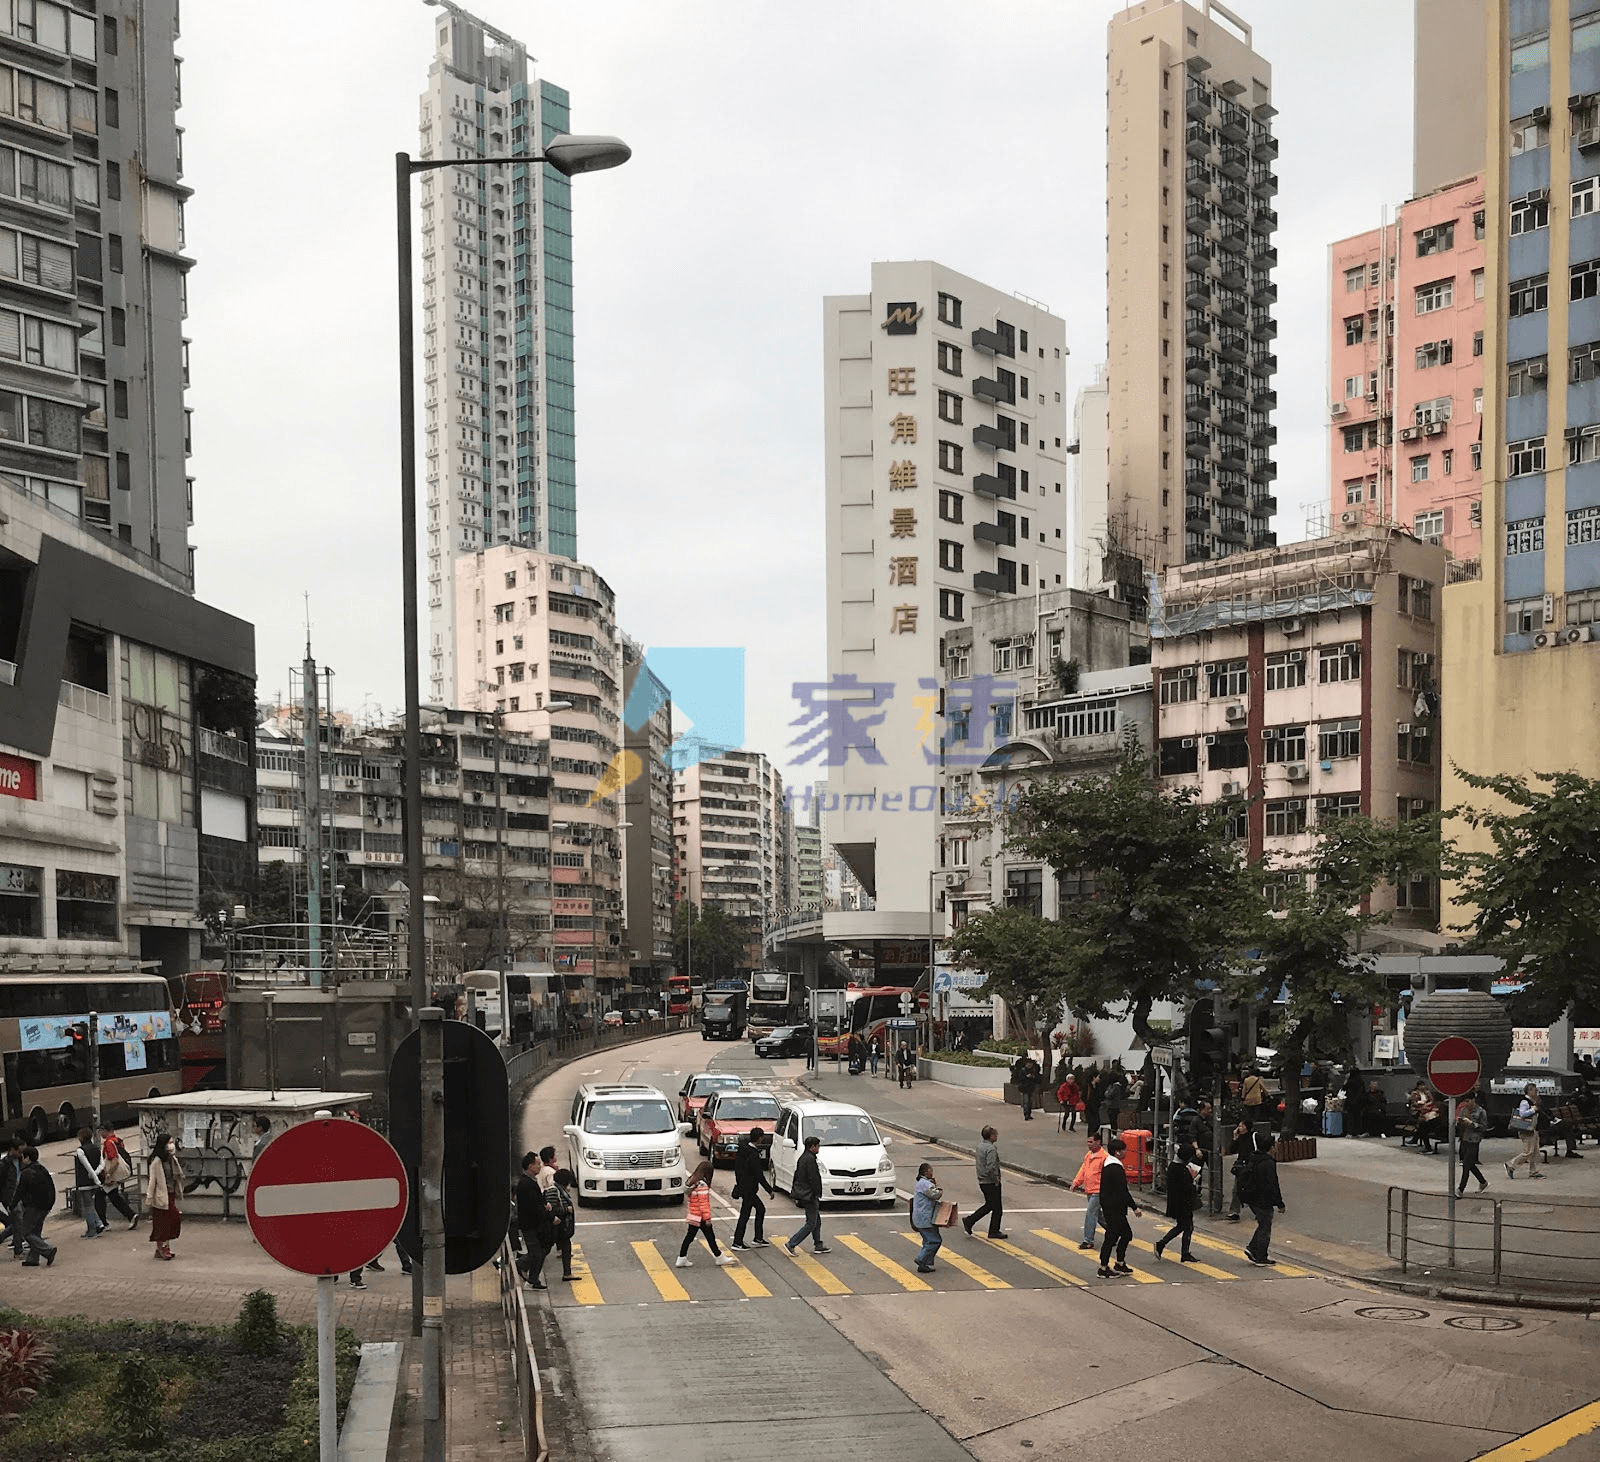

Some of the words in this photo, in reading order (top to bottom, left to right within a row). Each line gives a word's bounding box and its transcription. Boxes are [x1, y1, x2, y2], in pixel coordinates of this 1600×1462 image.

[887, 366, 919, 635] 旺角維景酒店
[1513, 519, 1539, 531] 1976
